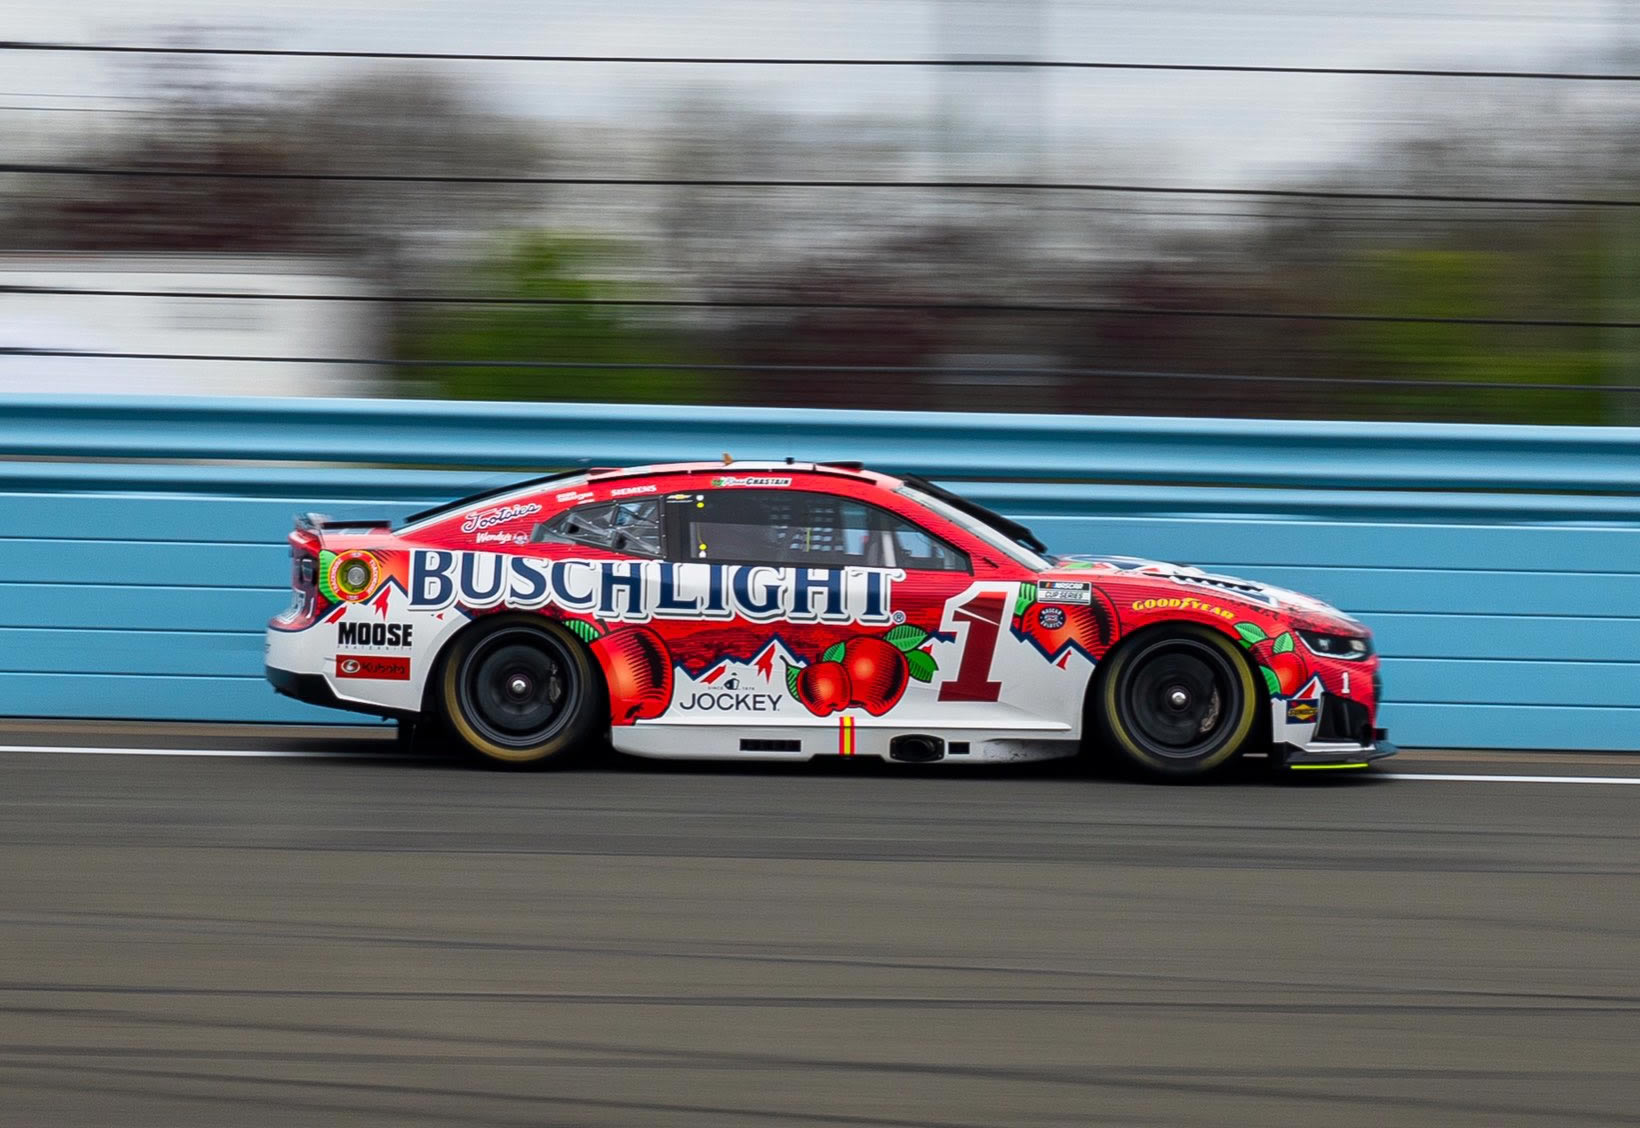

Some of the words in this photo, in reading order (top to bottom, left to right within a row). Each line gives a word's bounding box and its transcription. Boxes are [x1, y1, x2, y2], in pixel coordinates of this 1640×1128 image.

[1132, 598, 1235, 619] GOODYEAR
[338, 622, 413, 646] MOOSE
[938, 582, 1014, 702] 1
[1341, 672, 1350, 693] 1
[680, 693, 782, 711] JOCKEY
